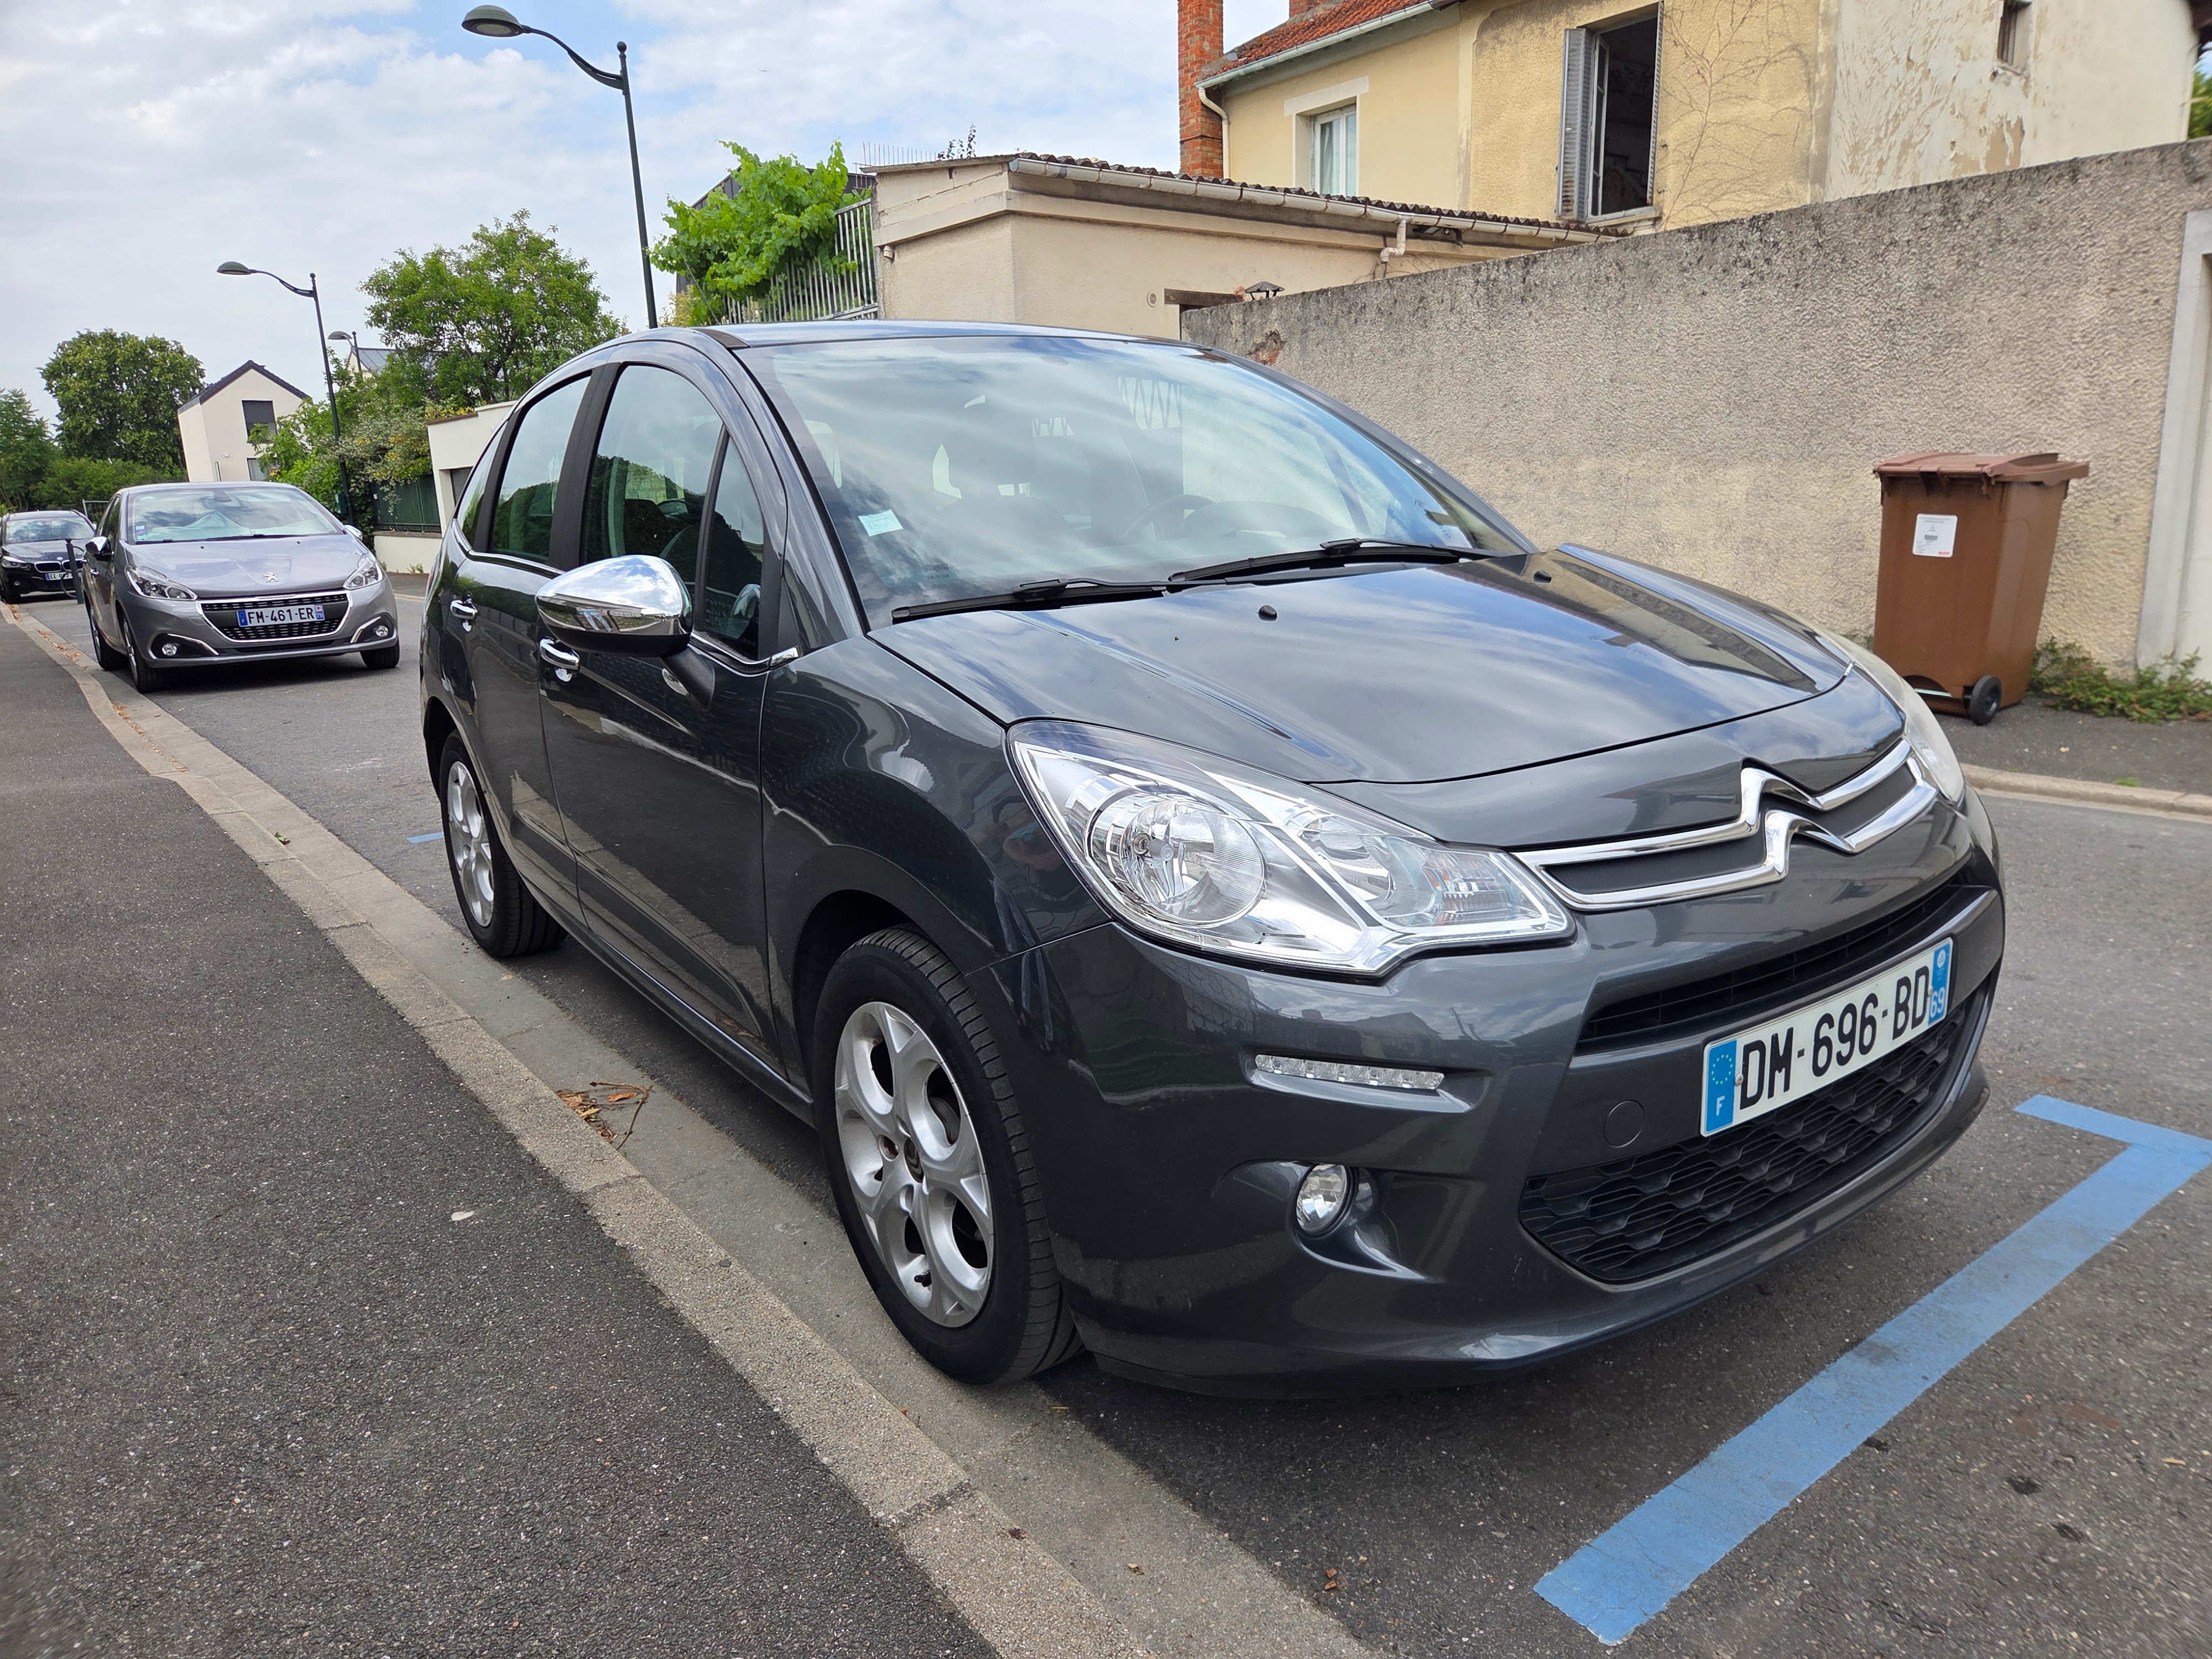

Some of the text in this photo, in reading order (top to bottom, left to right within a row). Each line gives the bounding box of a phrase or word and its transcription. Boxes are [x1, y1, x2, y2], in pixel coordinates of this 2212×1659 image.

[248, 607, 314, 624] FM-461-ER
[1930, 987, 1945, 1018] 69
[1740, 965, 1930, 1110] DM-696-BD
[1716, 1095, 1725, 1116] F
